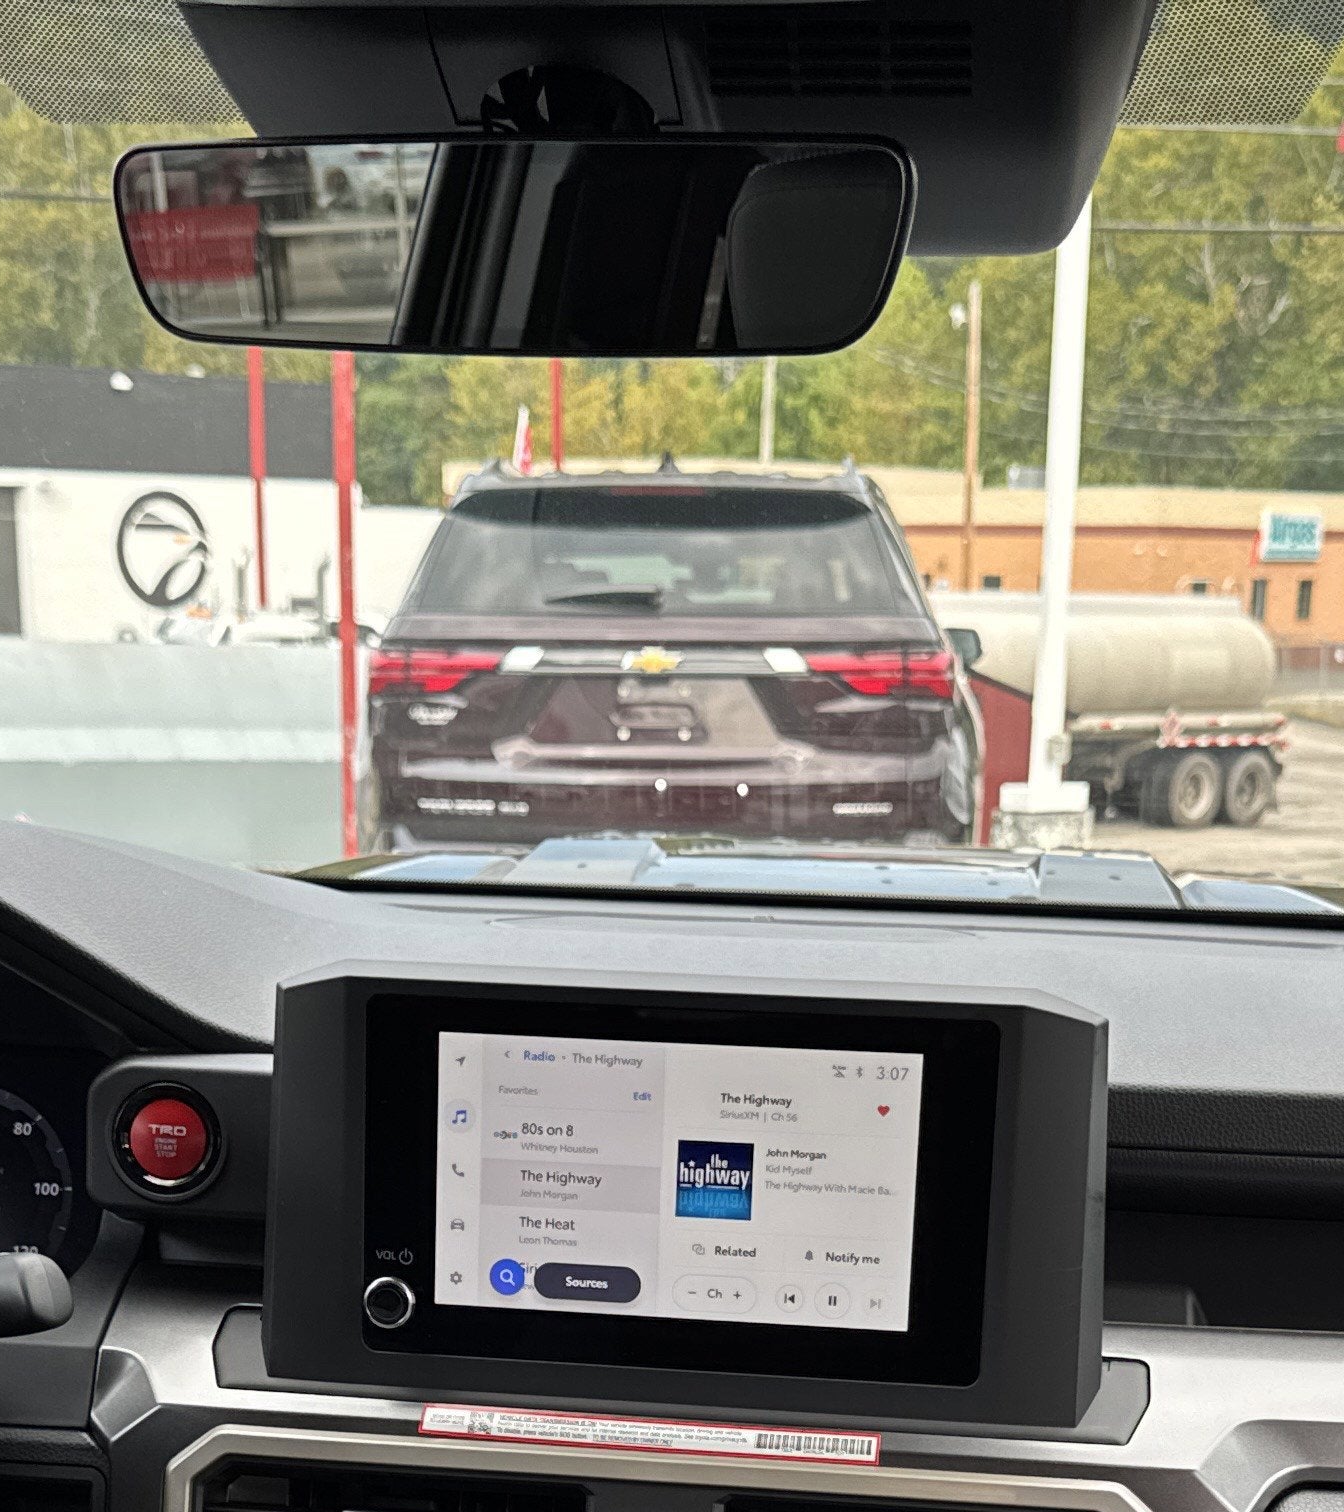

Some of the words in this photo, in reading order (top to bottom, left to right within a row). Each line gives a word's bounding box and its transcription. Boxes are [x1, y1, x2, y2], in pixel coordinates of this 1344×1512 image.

[523, 1050, 556, 1062] Radio
[572, 1053, 592, 1064] The
[594, 1054, 643, 1068] Highway
[498, 1086, 539, 1096] Favorites
[633, 1092, 652, 1101] Edit
[720, 1093, 741, 1104] The
[743, 1094, 792, 1108] Highway
[771, 1112, 785, 1121] Ch
[12, 1122, 32, 1136] 80
[148, 1123, 187, 1137] TRD
[521, 1123, 543, 1135] 80s
[546, 1127, 562, 1136] on
[565, 1125, 574, 1136] 8
[521, 1142, 556, 1153] Whitney
[559, 1145, 599, 1154] Houston
[711, 1154, 728, 1169] the
[766, 1149, 789, 1158] John
[791, 1150, 826, 1161] Morgan
[679, 1162, 750, 1190] highway
[766, 1165, 780, 1173] Kid
[783, 1166, 812, 1176] Myself
[520, 1170, 543, 1182] The
[545, 1171, 602, 1187] Highway
[34, 1182, 59, 1196] 100
[764, 1181, 781, 1190] The
[783, 1182, 822, 1194] Highway
[824, 1184, 846, 1193] With
[520, 1189, 541, 1199] John
[543, 1190, 578, 1201] Morgan
[519, 1216, 542, 1228] The
[545, 1218, 575, 1230] Heat
[543, 1237, 577, 1247] Thomas
[376, 1250, 396, 1260] VOL
[714, 1246, 756, 1257] Related
[825, 1252, 860, 1265] Notify
[861, 1255, 880, 1265] me
[565, 1276, 608, 1289] Sources
[707, 1289, 723, 1299] Ch
